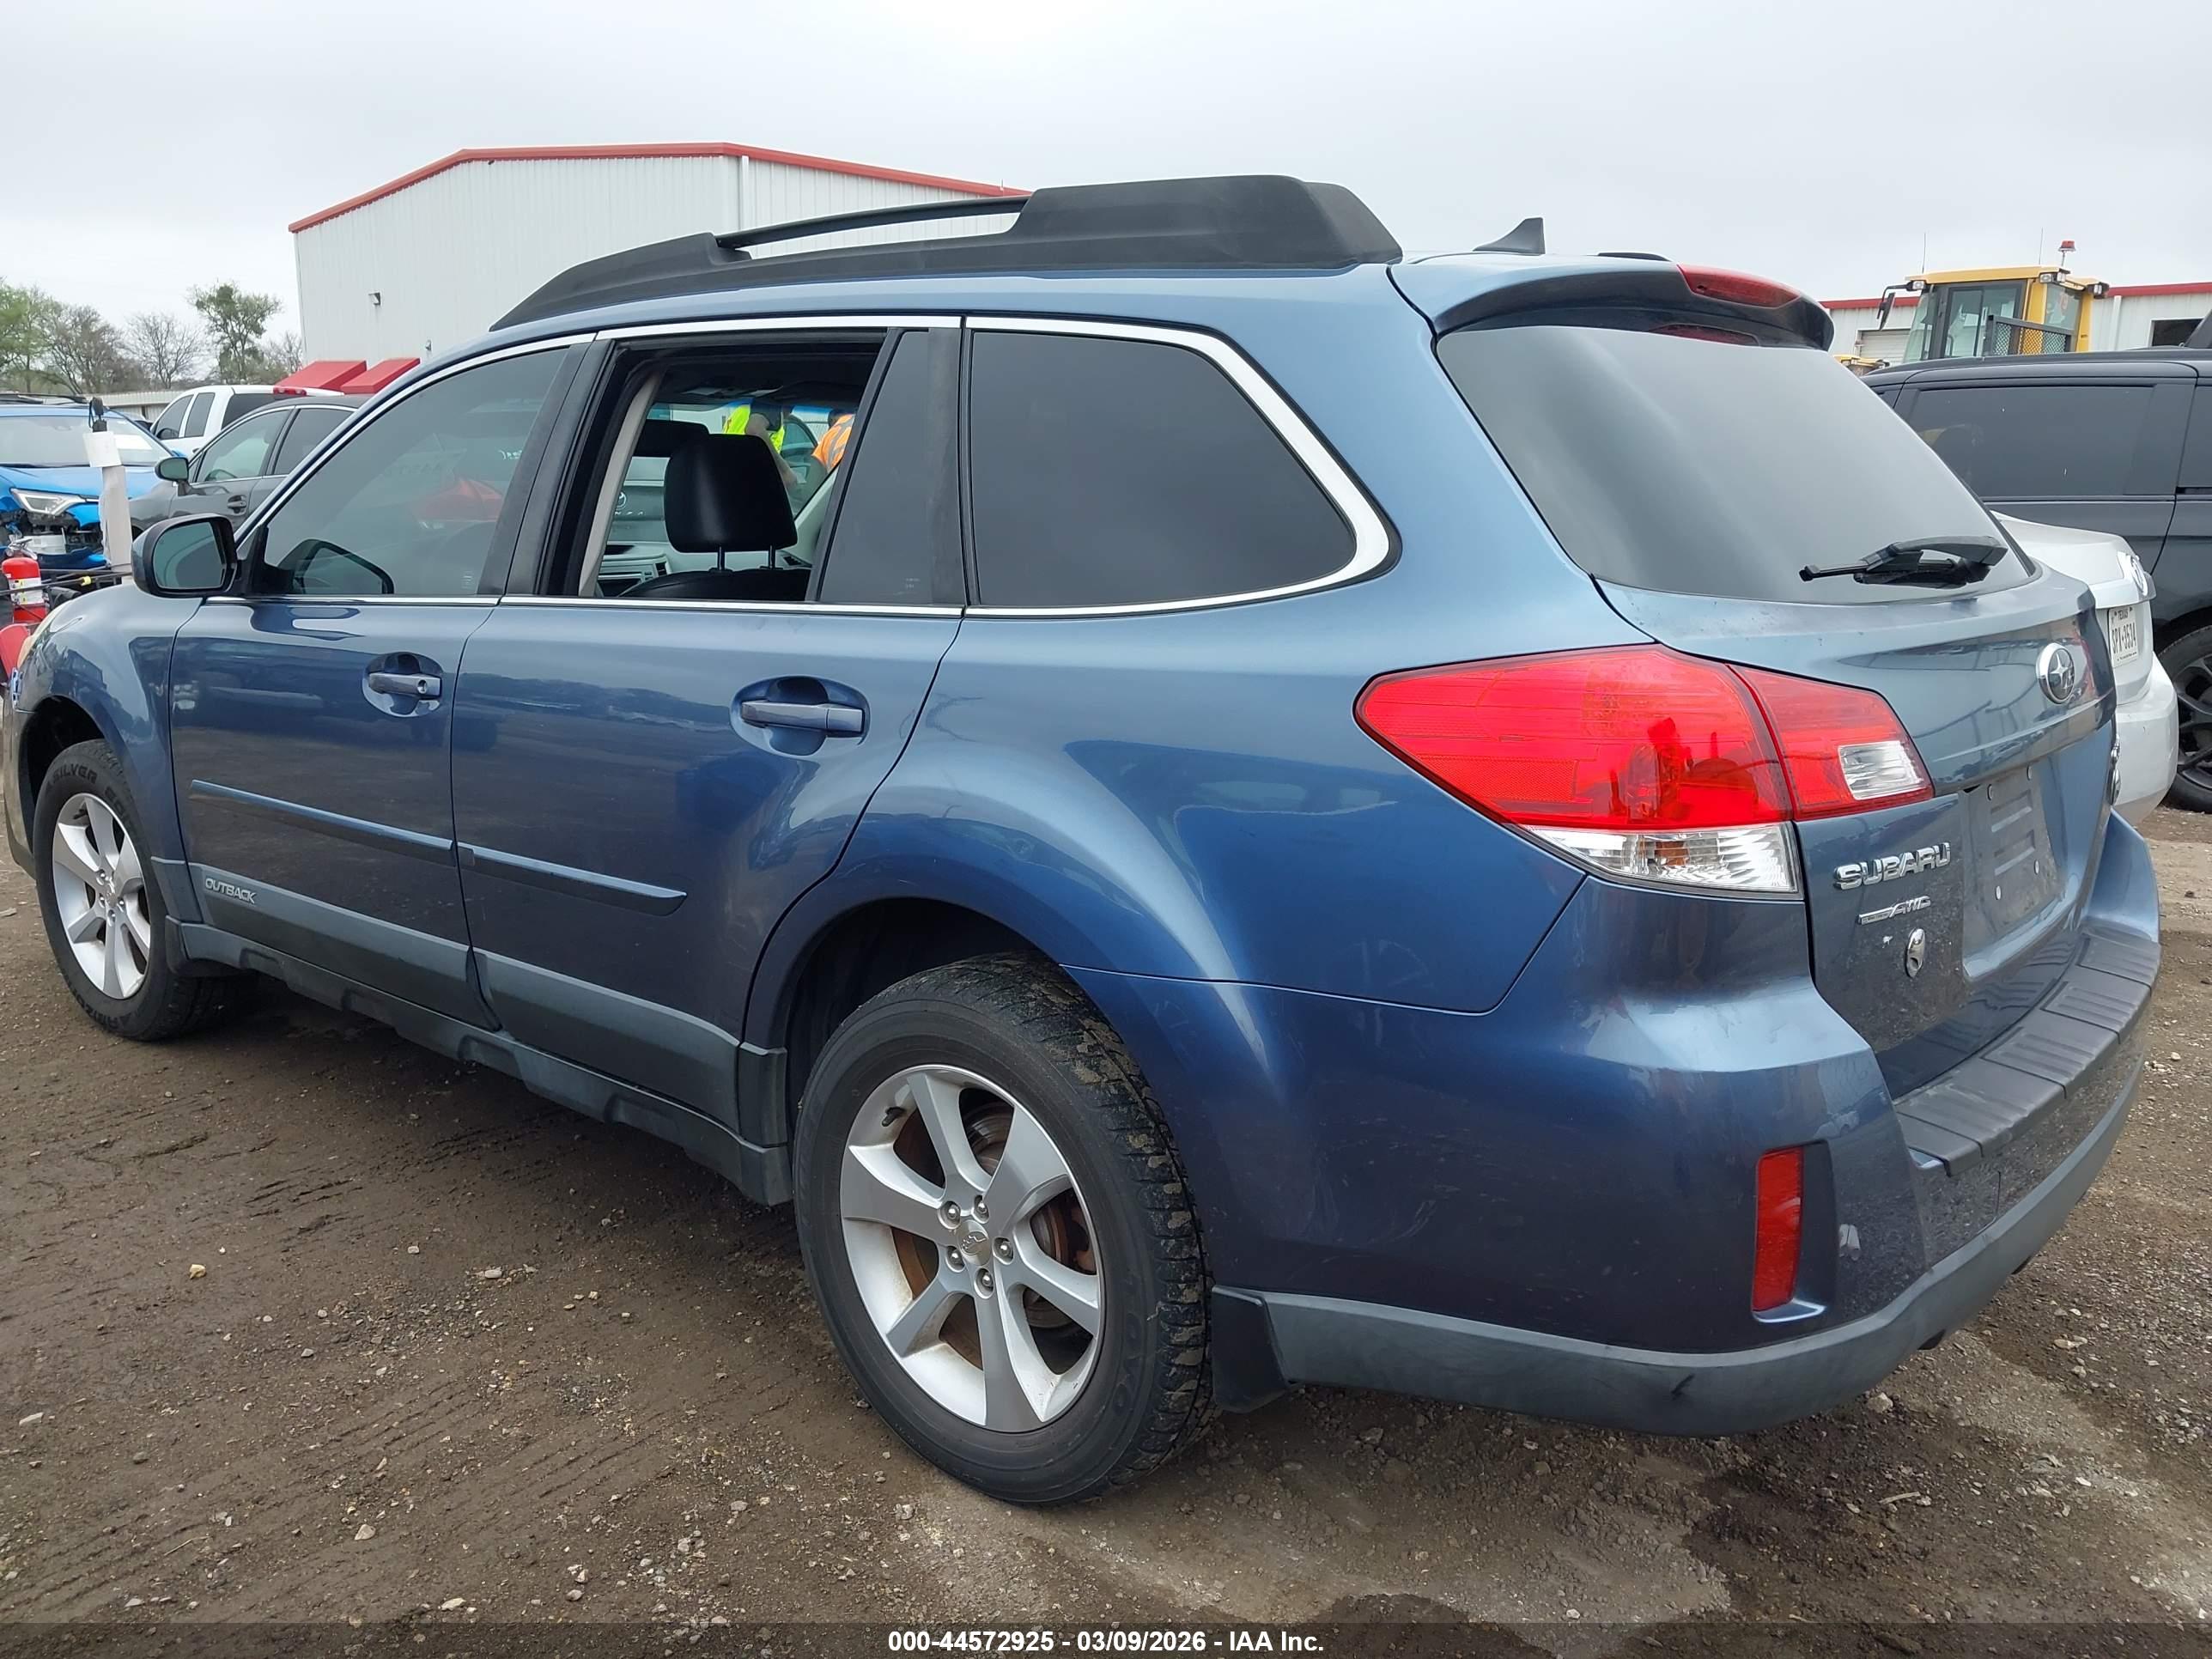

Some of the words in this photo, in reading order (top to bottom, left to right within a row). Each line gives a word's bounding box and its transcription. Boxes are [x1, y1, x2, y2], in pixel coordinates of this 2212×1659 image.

[53, 763, 98, 784] SILVER
[1833, 842, 1951, 890] SUBARU
[205, 878, 256, 904] OUTBACK
